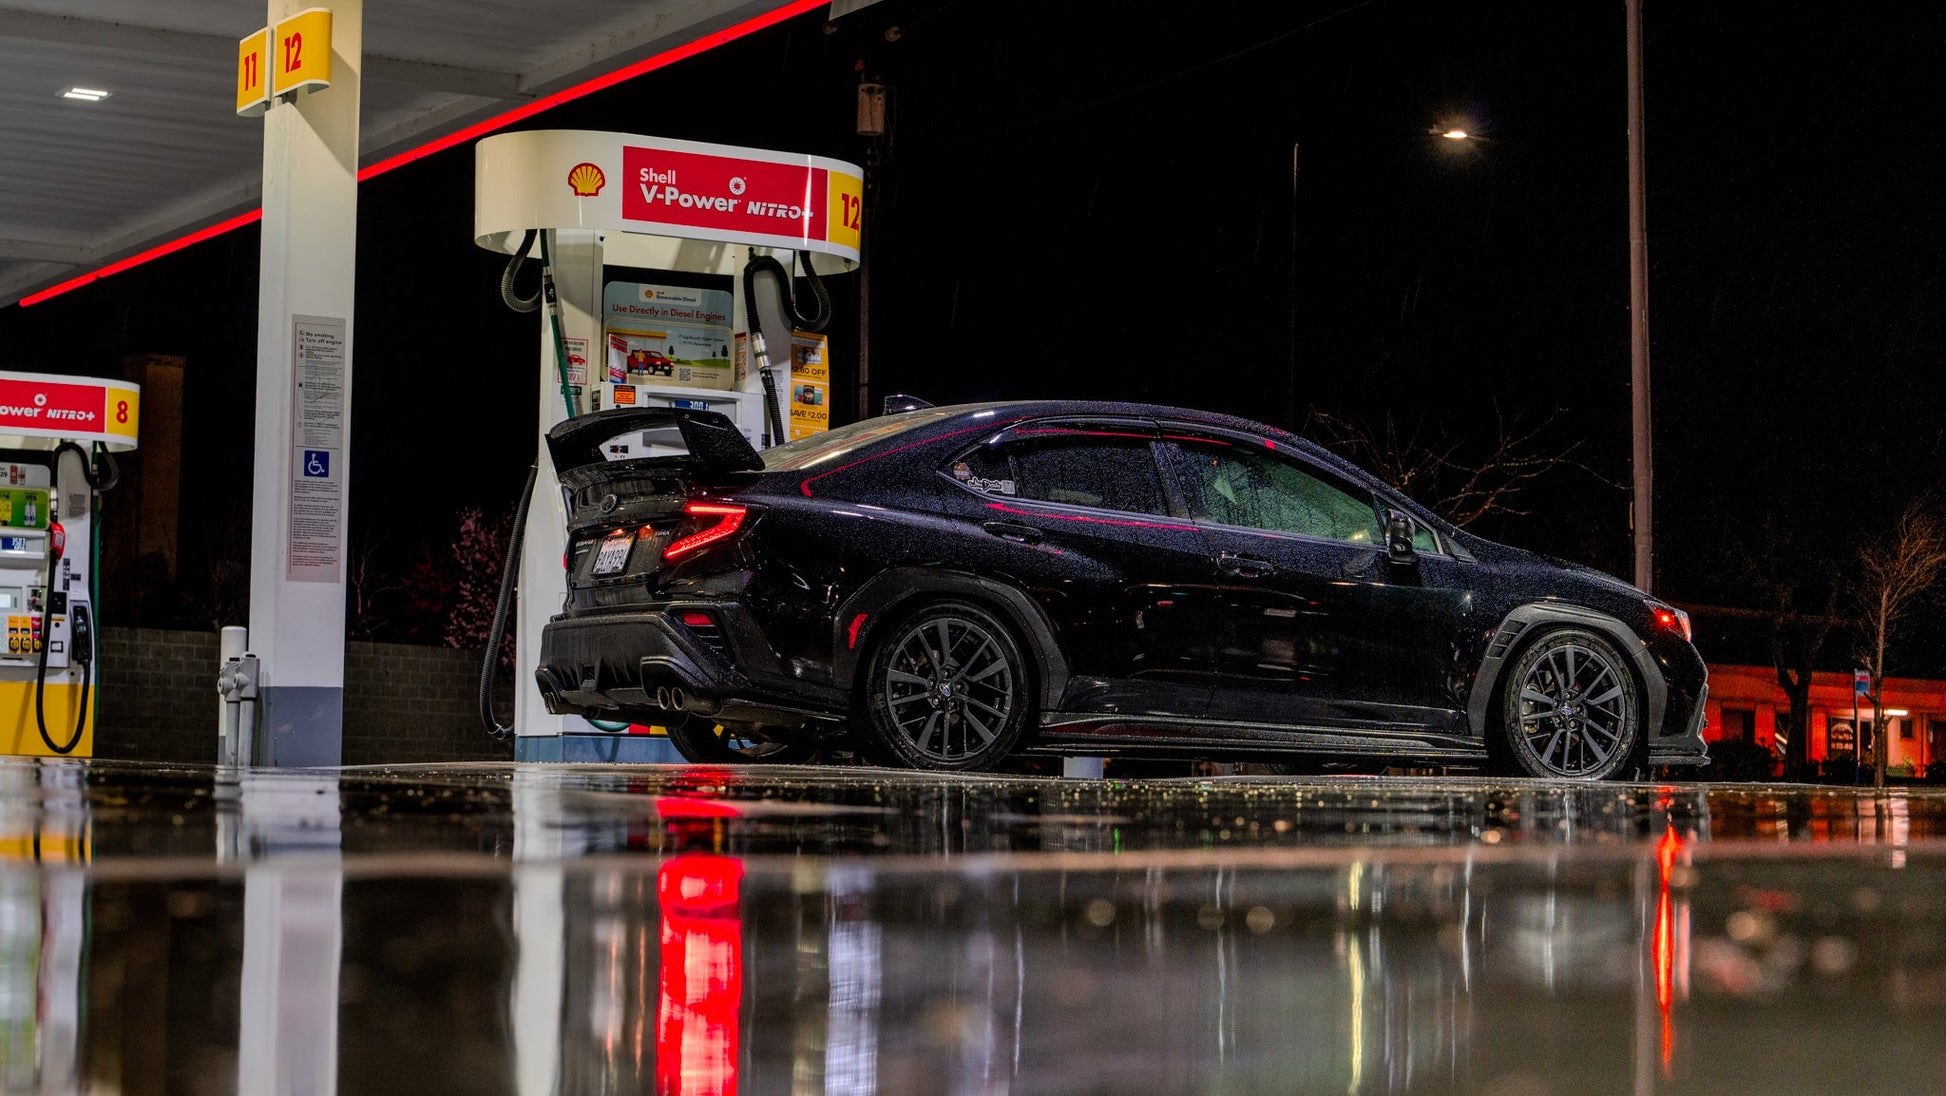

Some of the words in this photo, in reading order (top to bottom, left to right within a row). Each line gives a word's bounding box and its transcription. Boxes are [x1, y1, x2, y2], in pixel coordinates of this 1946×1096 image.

[284, 32, 302, 73] 12
[244, 51, 257, 91] 11
[640, 168, 676, 184] Shell
[640, 183, 738, 213] V-Power
[841, 192, 860, 231] 12
[612, 303, 627, 313] Use
[629, 304, 660, 317] Directly
[661, 307, 668, 316] in
[670, 308, 694, 318] Diesel
[696, 310, 726, 322] Engines
[811, 368, 826, 376] OFF
[116, 400, 128, 424] 8
[790, 409, 806, 418] SAVE
[808, 410, 827, 420] $2.00
